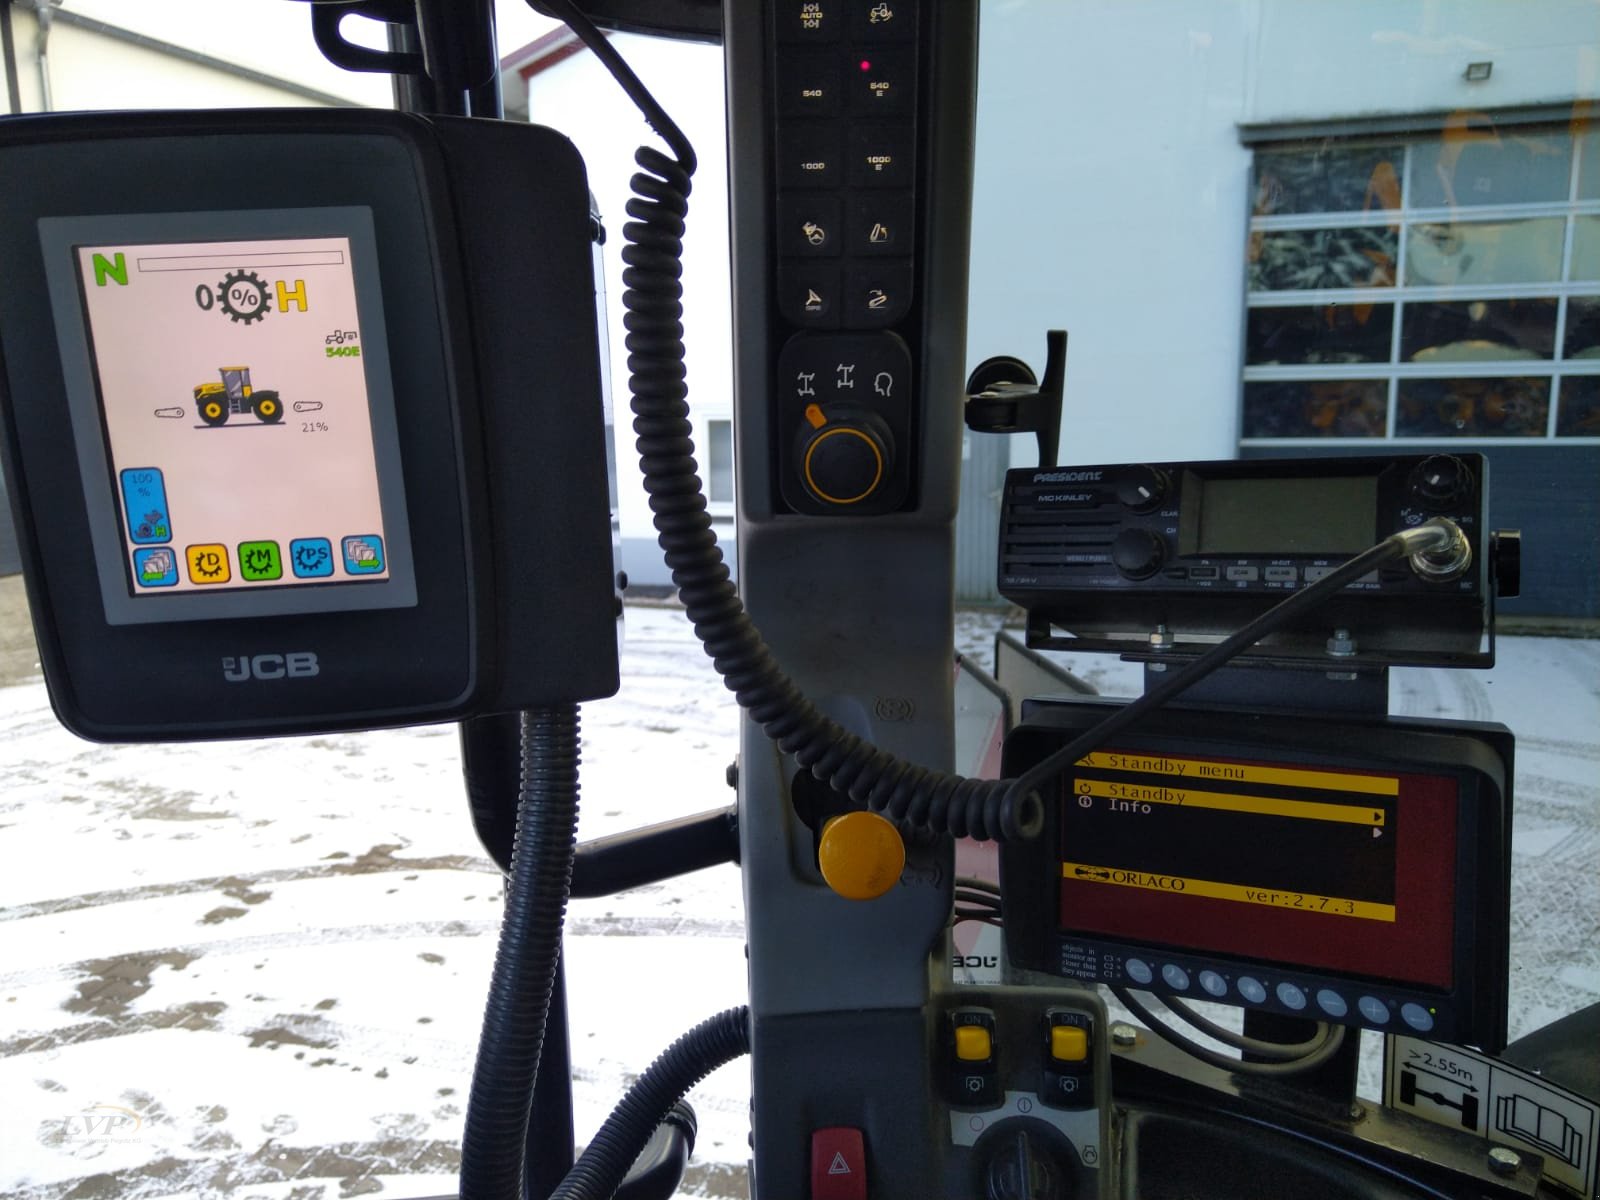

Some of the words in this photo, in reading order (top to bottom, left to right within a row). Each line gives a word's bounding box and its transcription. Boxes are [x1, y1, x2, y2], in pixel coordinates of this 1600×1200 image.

[92, 252, 128, 287] N
[231, 288, 258, 307] %
[275, 279, 308, 313] H
[325, 346, 360, 358] 540E
[301, 422, 328, 433] 21%
[132, 473, 152, 484] 100
[1033, 471, 1103, 483] PRESIDENT
[154, 525, 166, 538] H
[207, 552, 220, 566] D
[256, 549, 271, 562] M
[306, 547, 328, 560] PS
[221, 652, 320, 682] JCB
[1109, 754, 1187, 775] Standby
[1199, 764, 1245, 779] menu
[1108, 784, 1187, 804] Standby
[1108, 798, 1152, 815] Info
[1112, 870, 1186, 892] ORLACO
[1245, 889, 1354, 914] ver:2.7.3
[1104, 954, 1114, 962] C3
[1104, 962, 1114, 970] C2
[1104, 970, 1113, 978] C1
[964, 1016, 981, 1024] ON
